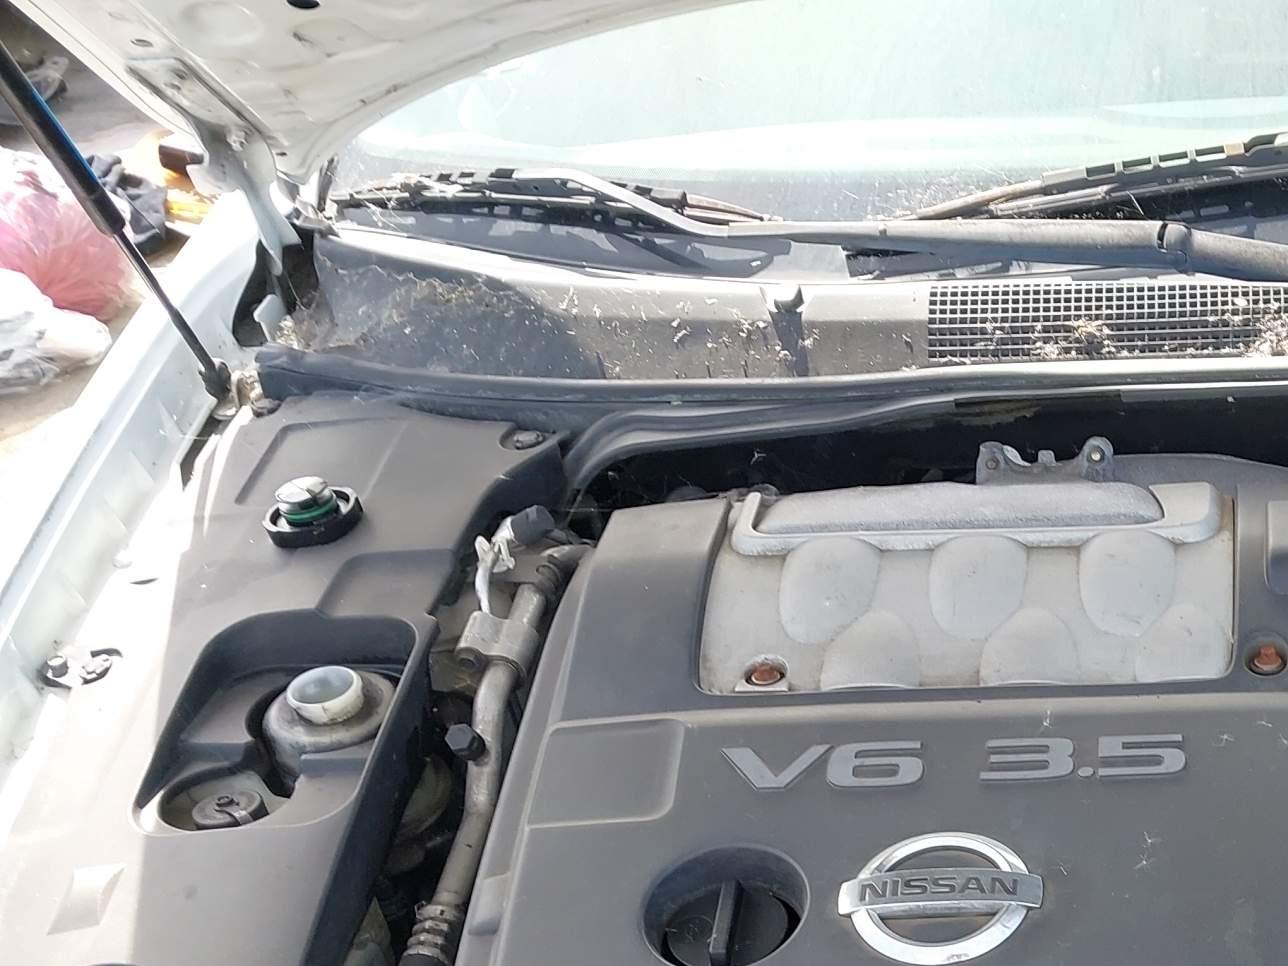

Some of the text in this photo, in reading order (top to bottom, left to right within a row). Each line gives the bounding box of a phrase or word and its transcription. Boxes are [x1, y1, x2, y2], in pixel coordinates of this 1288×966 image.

[720, 734, 1186, 791] V6 3.5
[859, 877, 1018, 901] NISSAN
